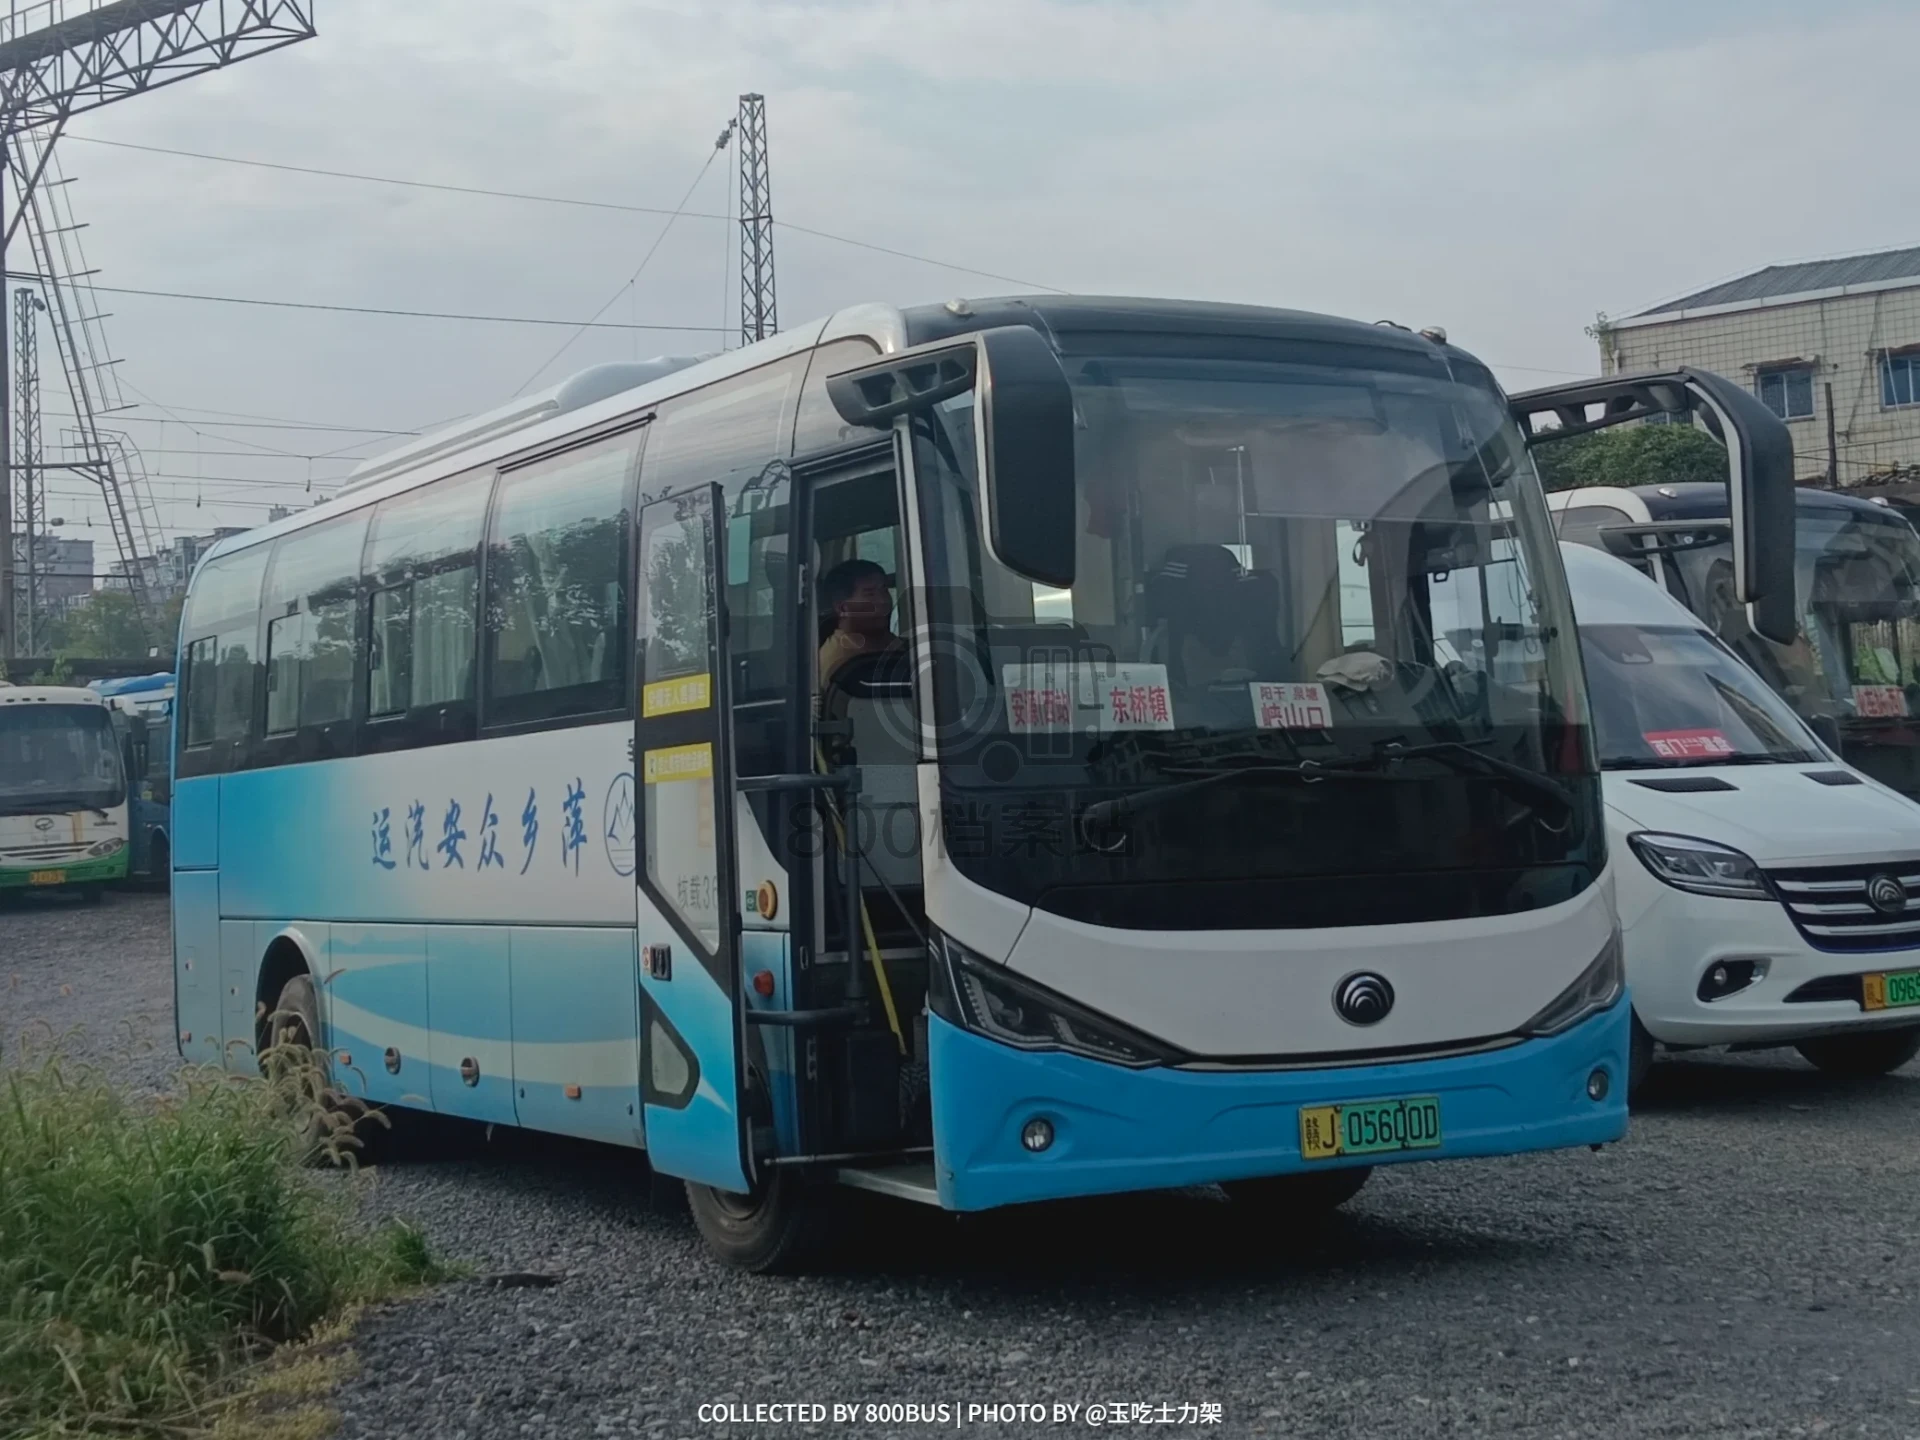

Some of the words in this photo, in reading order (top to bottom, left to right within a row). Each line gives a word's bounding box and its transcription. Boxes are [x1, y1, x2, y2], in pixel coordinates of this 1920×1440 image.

[1109, 685, 1169, 724] 东桥镇
[1261, 702, 1325, 729] 峡山口
